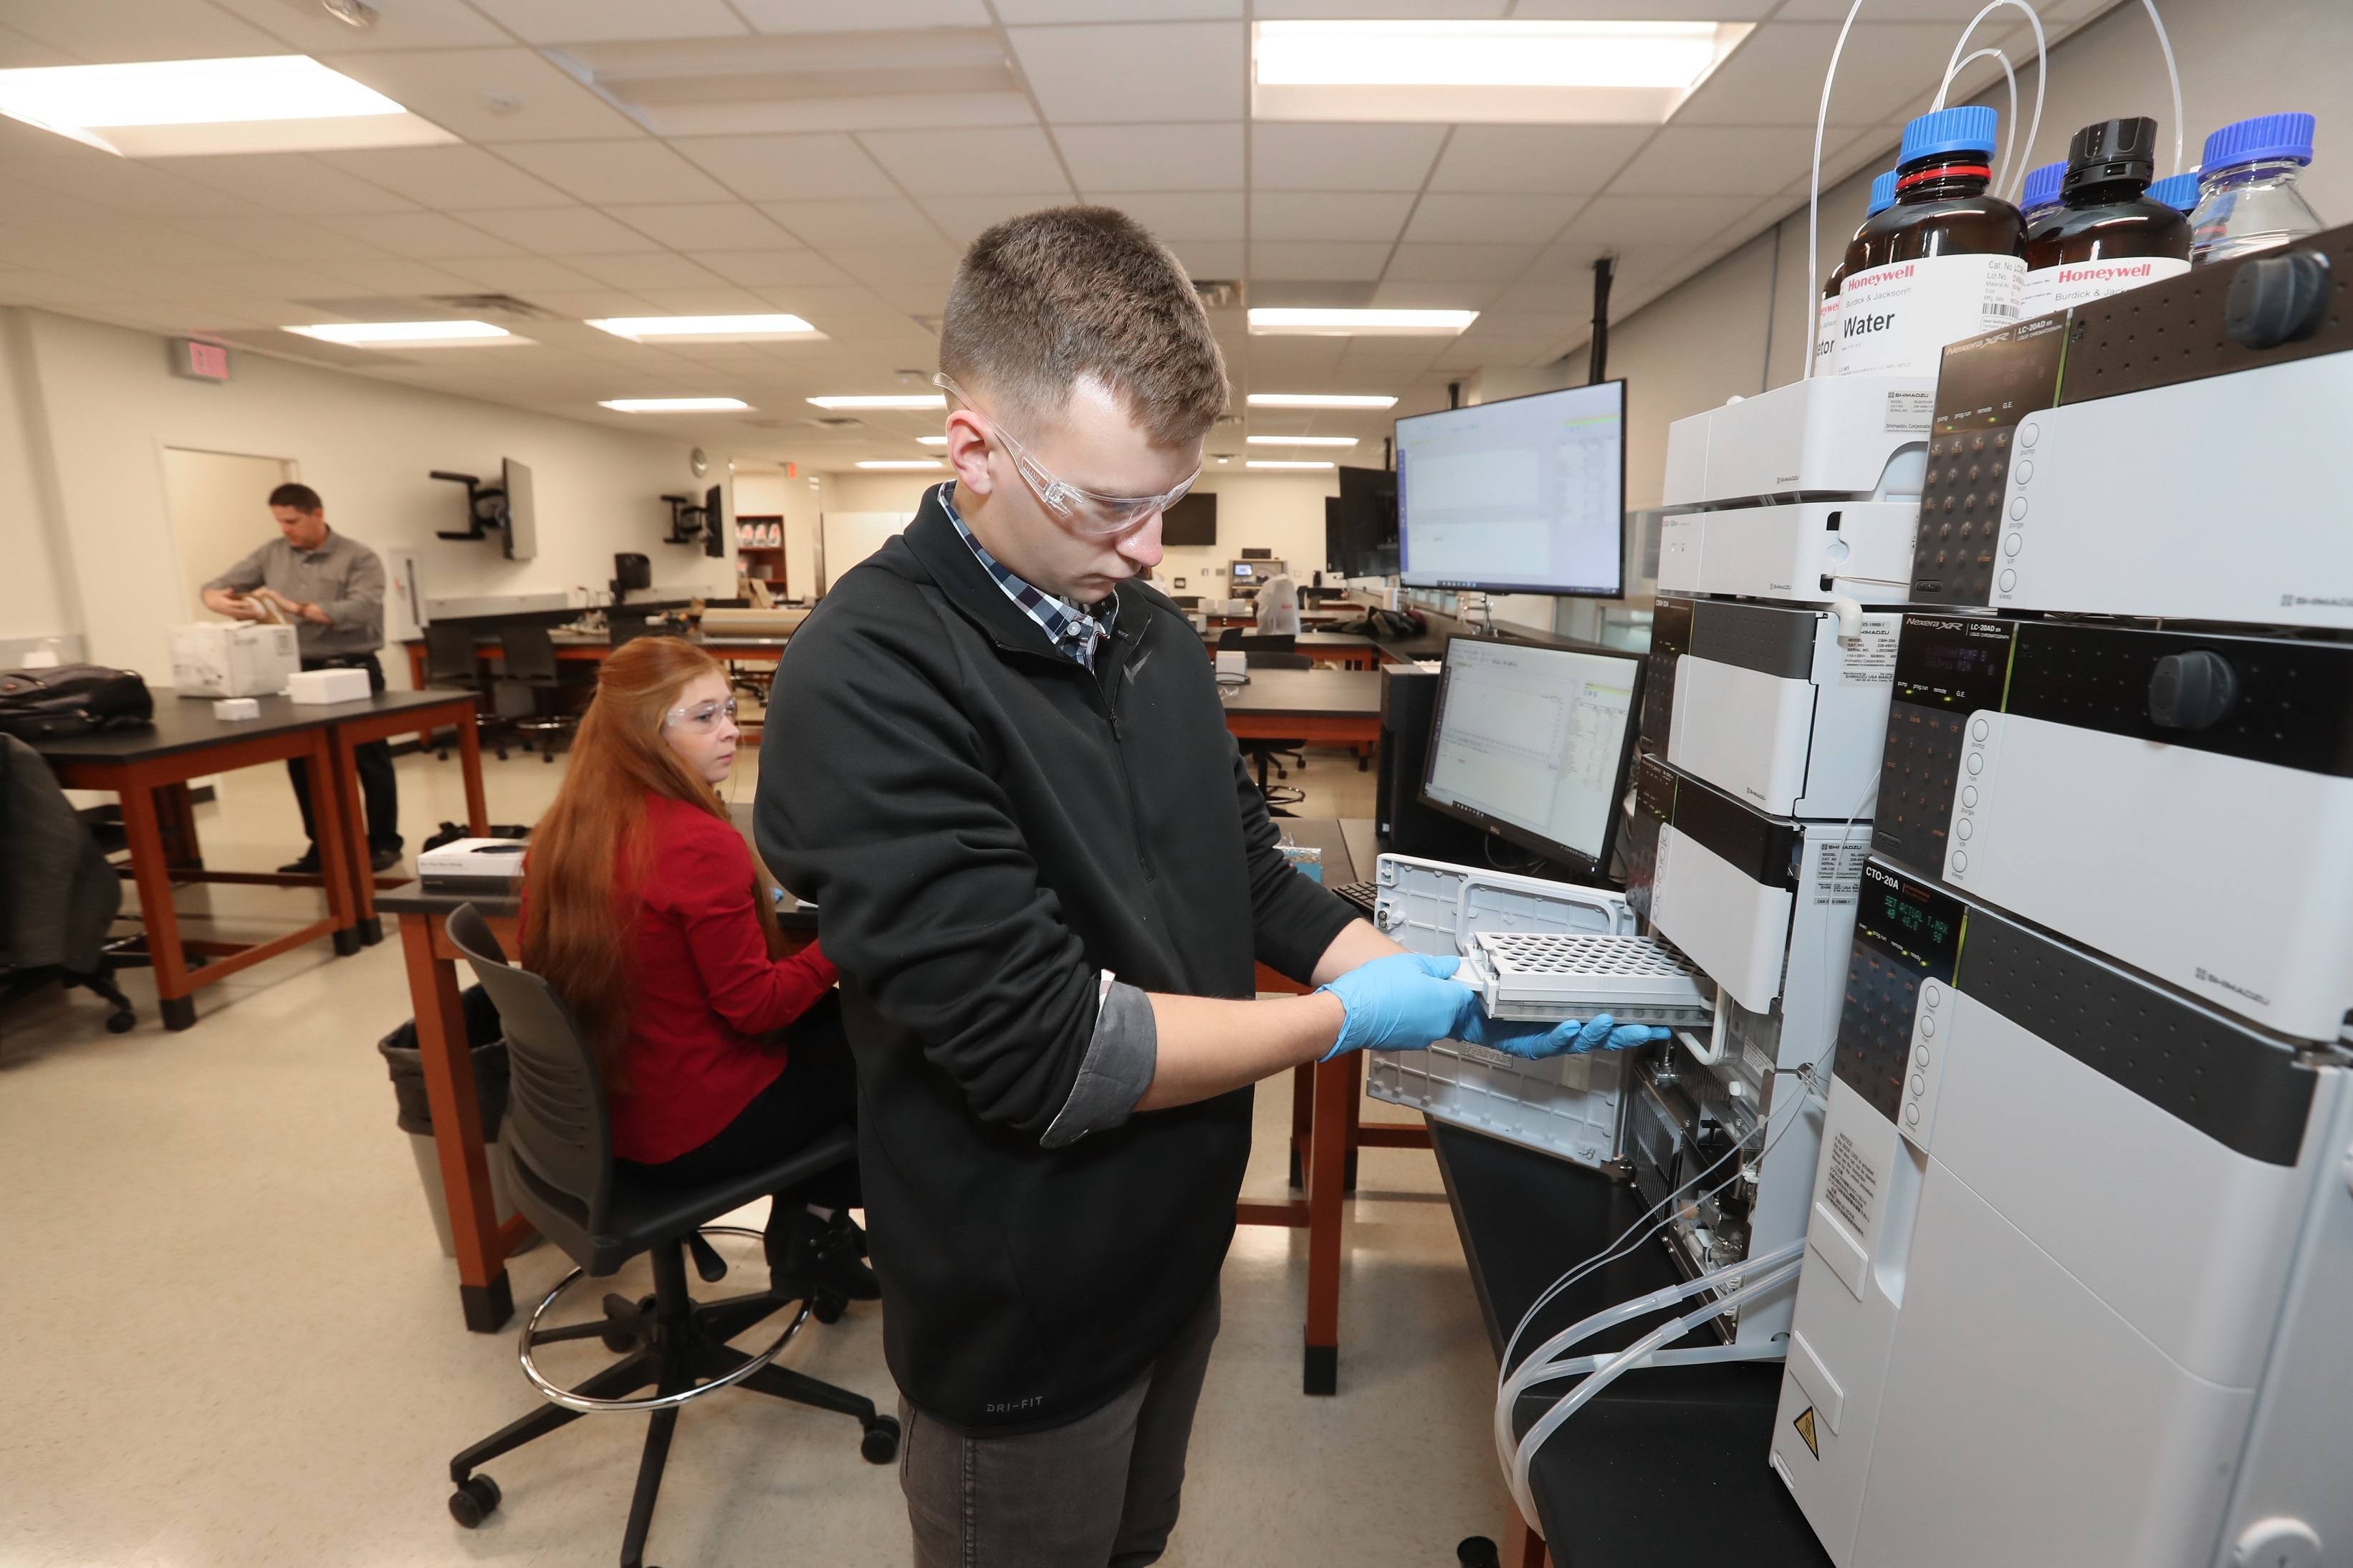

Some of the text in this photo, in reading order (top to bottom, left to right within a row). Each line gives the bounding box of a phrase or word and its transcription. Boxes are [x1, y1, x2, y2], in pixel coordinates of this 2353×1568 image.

[1849, 264, 1914, 292] Honeywell
[2058, 264, 2152, 284] Honeywell
[1846, 296, 1865, 309] Burdick
[2055, 290, 2091, 301] Burdick
[2093, 289, 2100, 297] &
[1844, 313, 1896, 339] Water
[2018, 320, 2046, 335] LC-20AD
[1945, 340, 1983, 356] Nexera
[1906, 617, 1964, 631] Nexera XR
[1970, 624, 1995, 633] LC-20AD
[1866, 866, 1899, 890] CTO-20A
[1884, 895, 1897, 909] SET
[1839, 1132, 1852, 1148] NOTICE
[986, 1395, 1043, 1413] DRI-FIT
